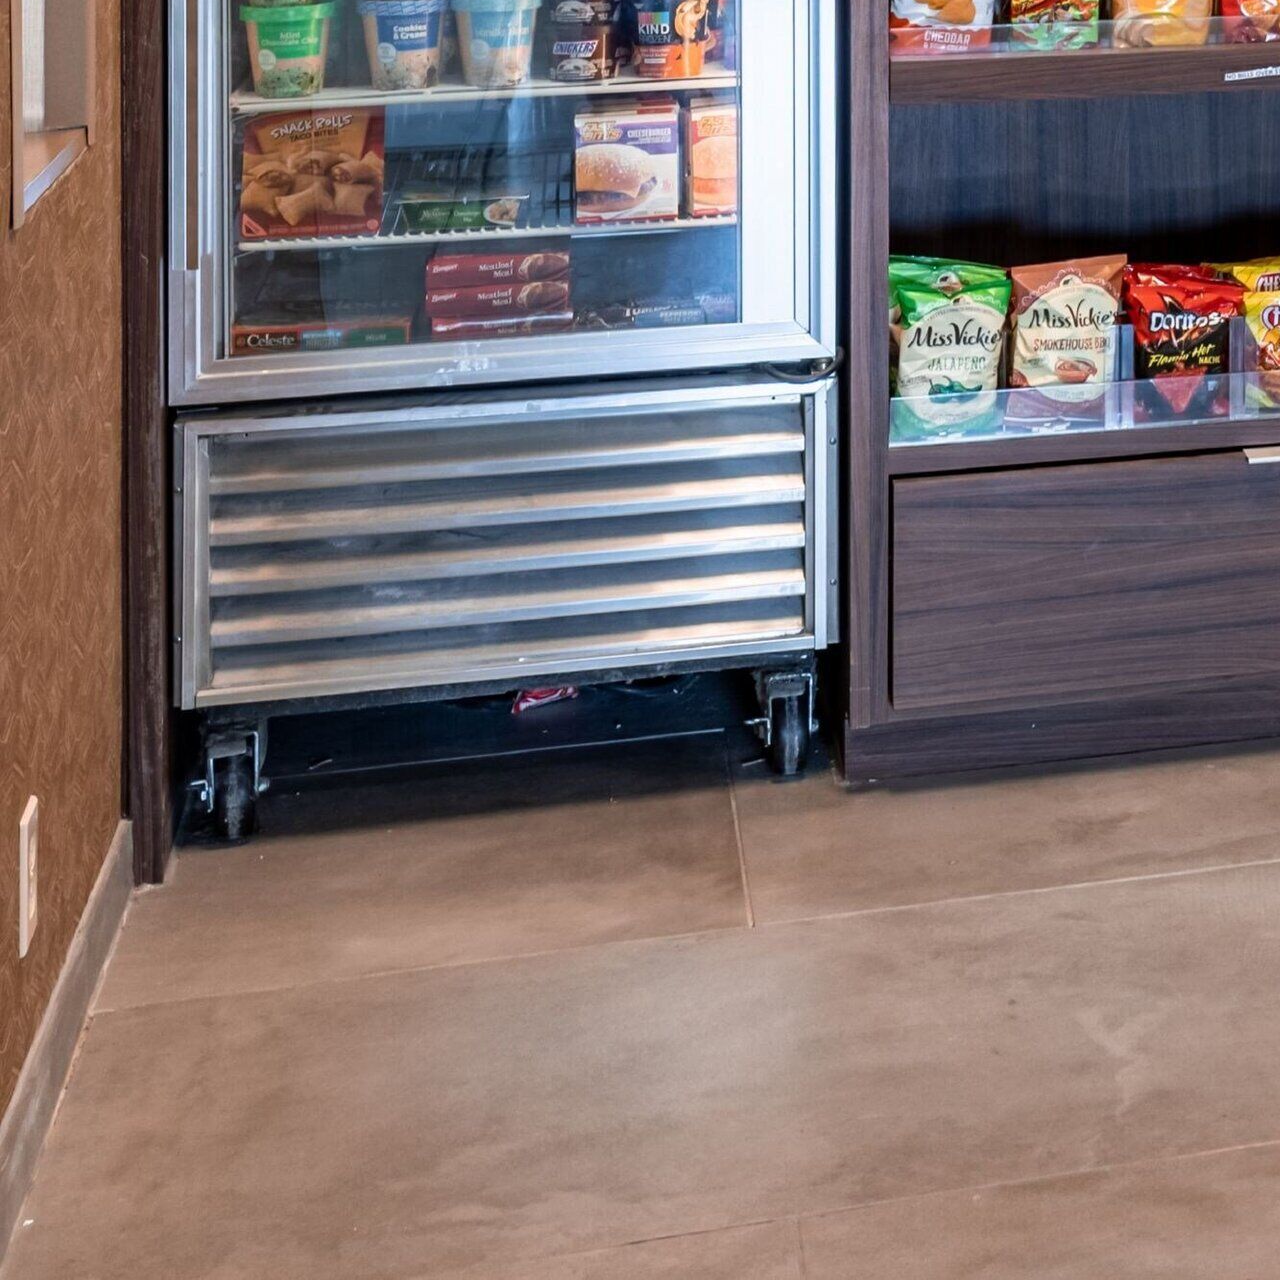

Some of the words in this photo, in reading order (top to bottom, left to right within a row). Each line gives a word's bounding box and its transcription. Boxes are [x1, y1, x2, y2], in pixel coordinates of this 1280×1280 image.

[393, 24, 427, 33] Cookies
[638, 24, 670, 35] KIND
[924, 30, 970, 45] CHEDDAR
[553, 41, 597, 54] SNICKERS
[1254, 68, 1273, 77] OVER
[271, 119, 312, 139] SNACK
[315, 114, 353, 130] ROLLS
[1028, 308, 1072, 330] Miss
[1150, 311, 1222, 332] Doritos
[247, 333, 296, 347] Celeste
[908, 325, 951, 348] Miss
[1033, 336, 1094, 352] SMOKEHOUSE
